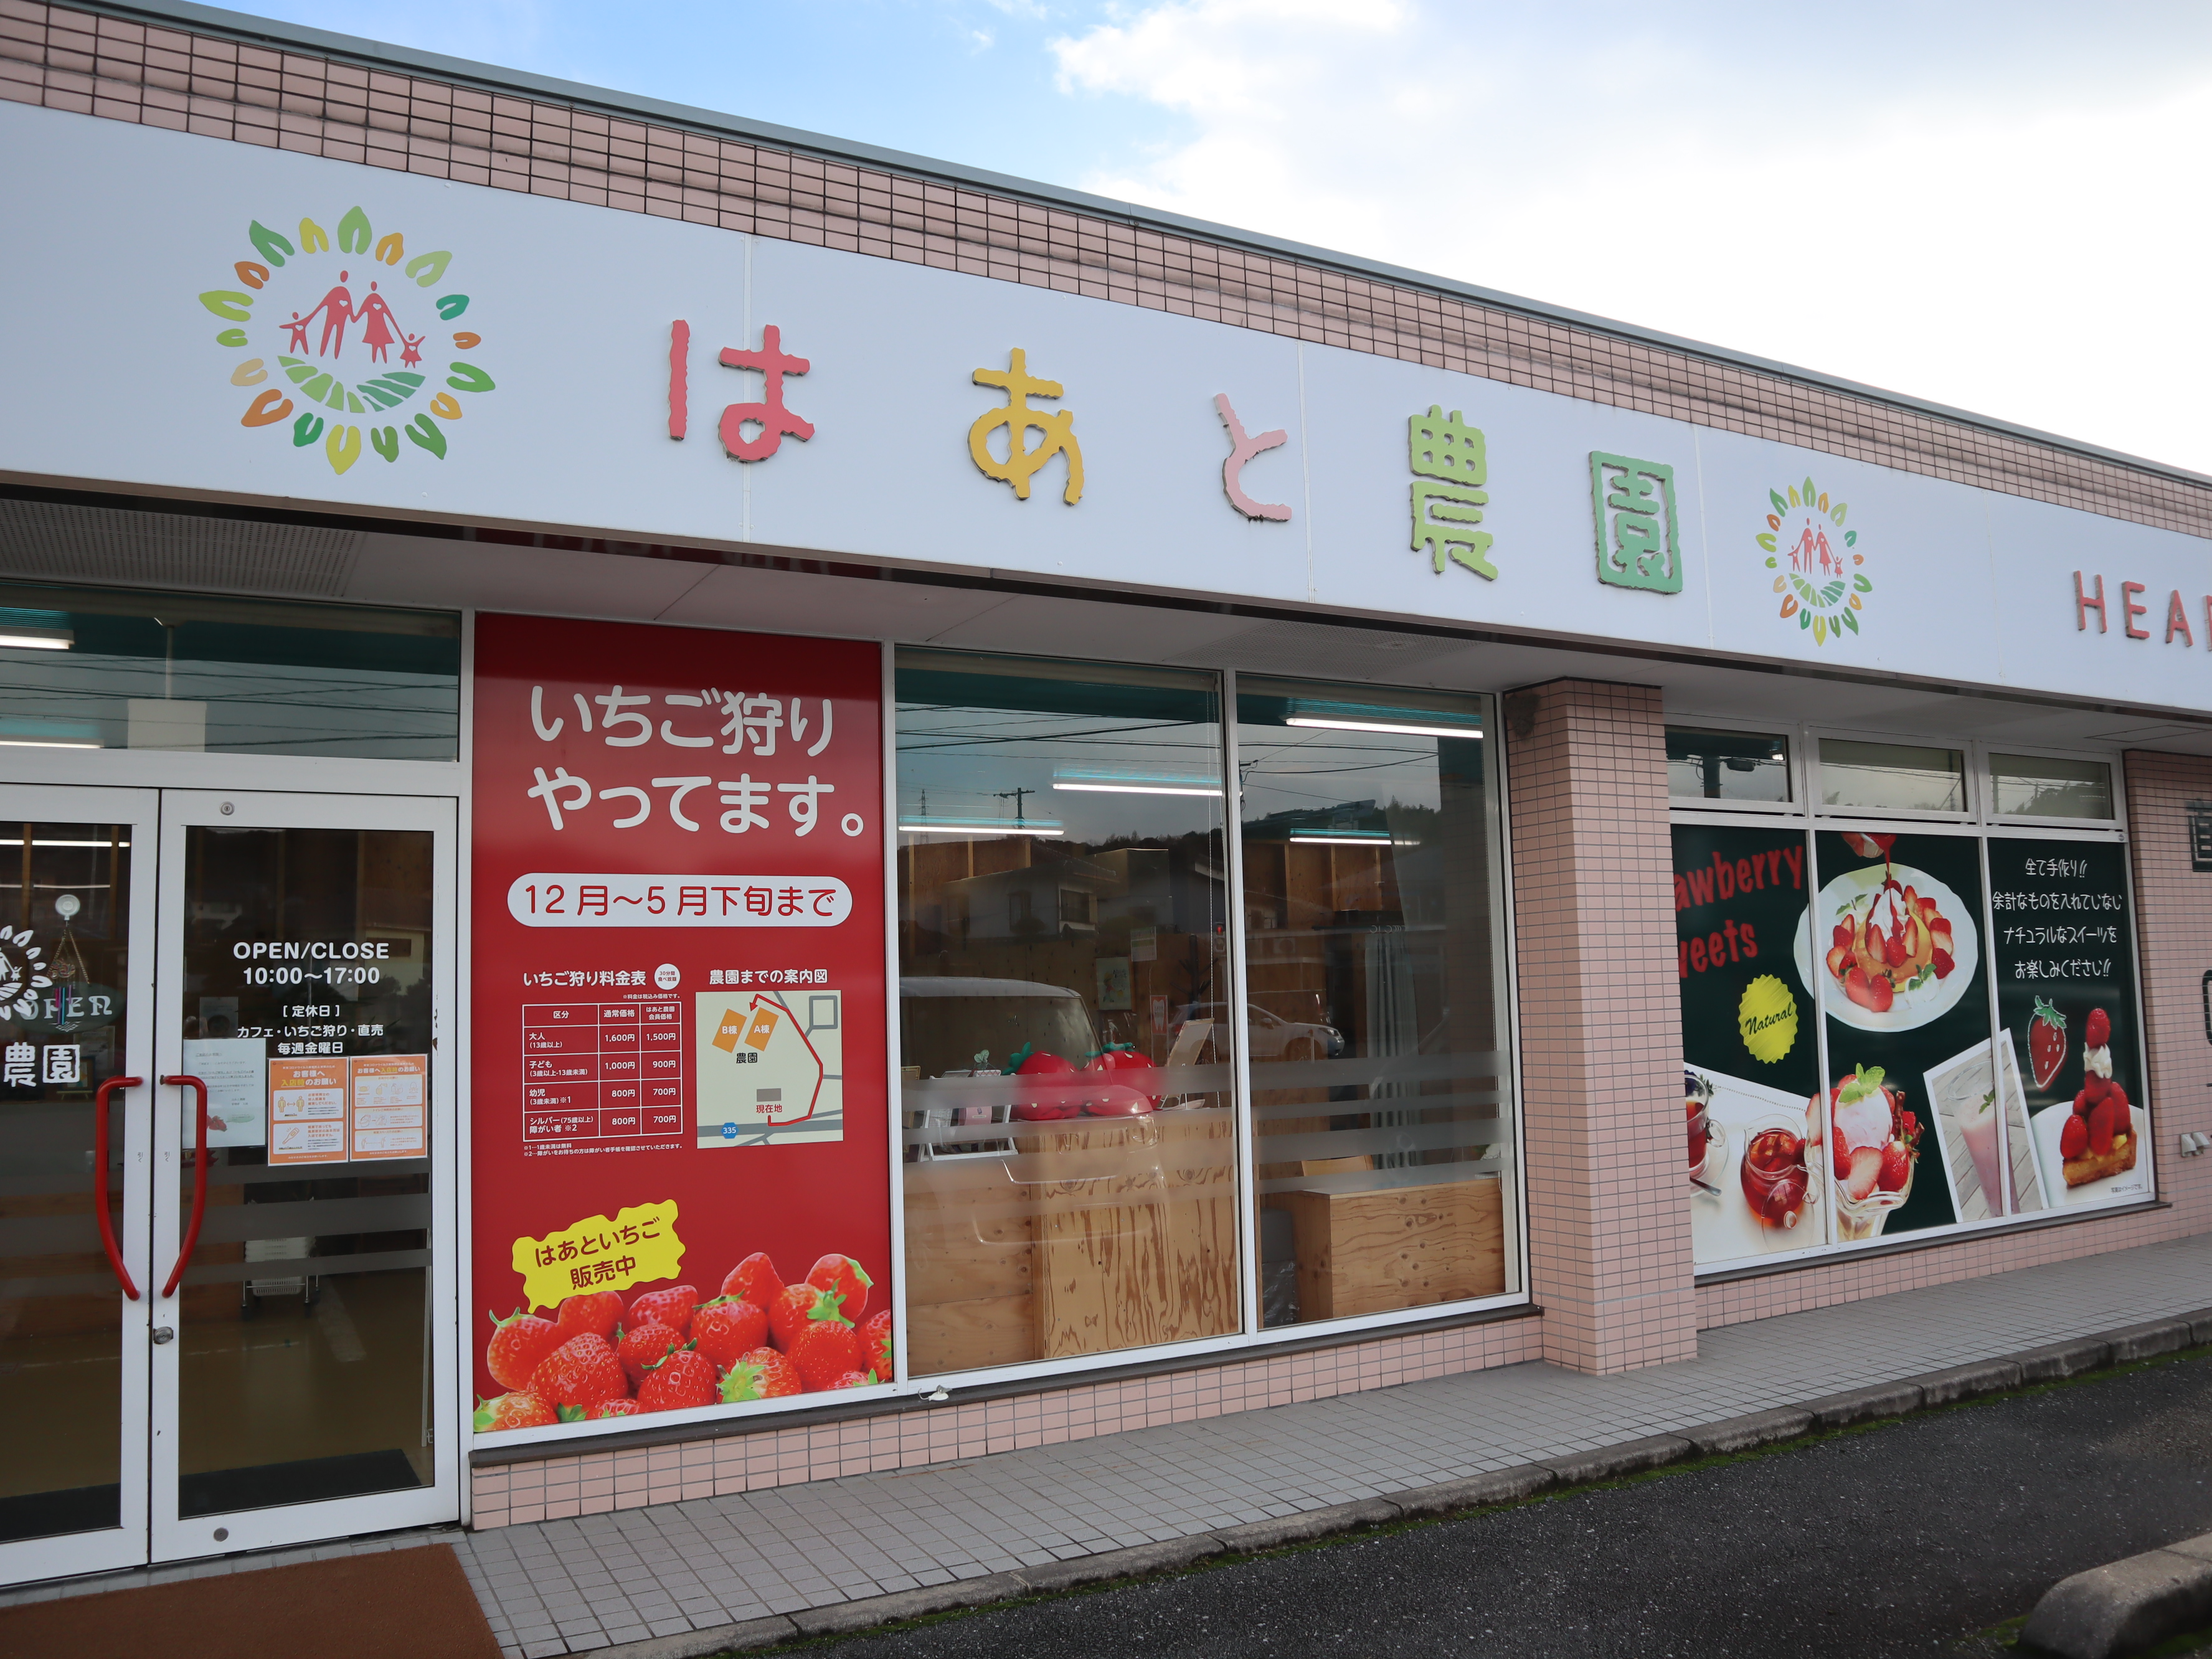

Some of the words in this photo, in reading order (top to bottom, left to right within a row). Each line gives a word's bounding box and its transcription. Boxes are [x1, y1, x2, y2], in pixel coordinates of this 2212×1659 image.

[668, 318, 1683, 593] はあと農園
[531, 685, 833, 757] いちご狩り
[527, 767, 864, 836] やってます。
[1993, 891, 2122, 910] 余計なものを入れていない
[2003, 926, 2117, 944] ナチュラルなスイーツを
[234, 942, 389, 959] OPEN/CLOSE
[523, 970, 646, 986] いちご狩り料金表
[709, 968, 828, 985] 農園までの案内図
[553, 1010, 569, 1019] 区分
[603, 1009, 635, 1018] 通常価格
[1745, 1001, 1794, 1036] Natural
[722, 1026, 737, 1035] B棟
[754, 1025, 770, 1034] A棟
[529, 1032, 546, 1041] 大人
[605, 1034, 635, 1042] 1,600円
[646, 1033, 676, 1041] 1,500円
[278, 1042, 343, 1054] 毎週金曜日
[529, 1041, 562, 1049] (13歳以上)
[736, 1052, 758, 1064] 農園
[3, 1042, 80, 1087] 農園
[529, 1061, 552, 1069] 子ども
[605, 1061, 635, 1070] 1,000円
[653, 1060, 676, 1069] 900円
[293, 1070, 325, 1078] お客様へ
[281, 1078, 336, 1087] 入店時のお願い
[529, 1089, 546, 1097] 幼児
[612, 1089, 635, 1098] 800円
[653, 1087, 676, 1096] 700円
[756, 1104, 783, 1113] 現在地
[612, 1117, 635, 1125] 800円
[653, 1115, 676, 1123] 700円
[529, 1125, 562, 1134] 障がい者
[535, 1216, 660, 1267] はあといちご
[570, 1255, 636, 1290] 販売中
